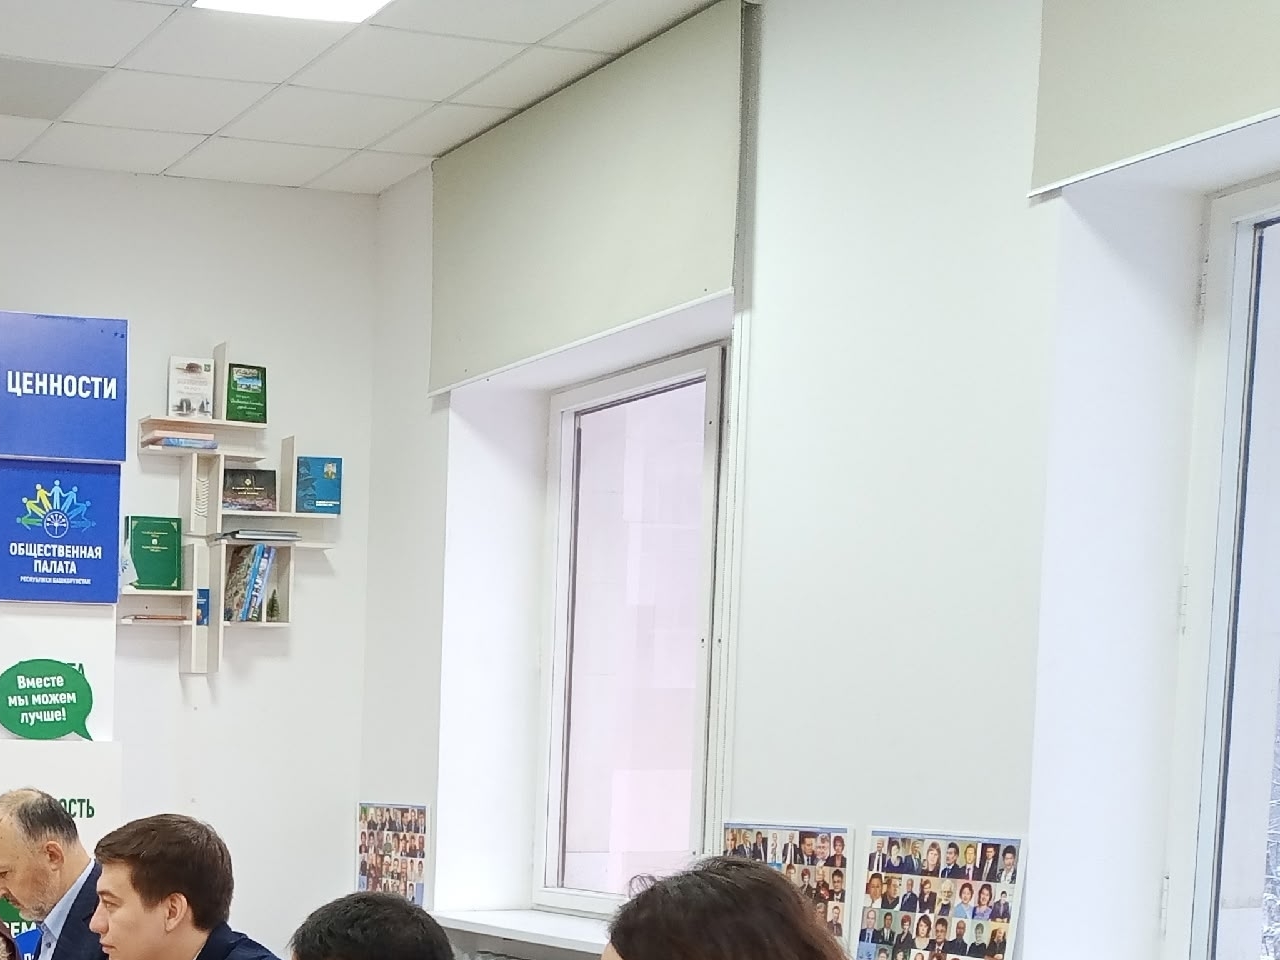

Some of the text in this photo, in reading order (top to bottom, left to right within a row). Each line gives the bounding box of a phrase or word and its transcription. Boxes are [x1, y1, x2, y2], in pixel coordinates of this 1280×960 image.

[7, 371, 118, 400] ЦЕННОСТИ
[9, 542, 102, 560] ОБЩЕСТВЕННАЯ
[33, 559, 77, 574] ПАЛАТА
[17, 675, 65, 689] Вместе
[8, 692, 77, 707] мы можем
[20, 706, 67, 727] лучше!
